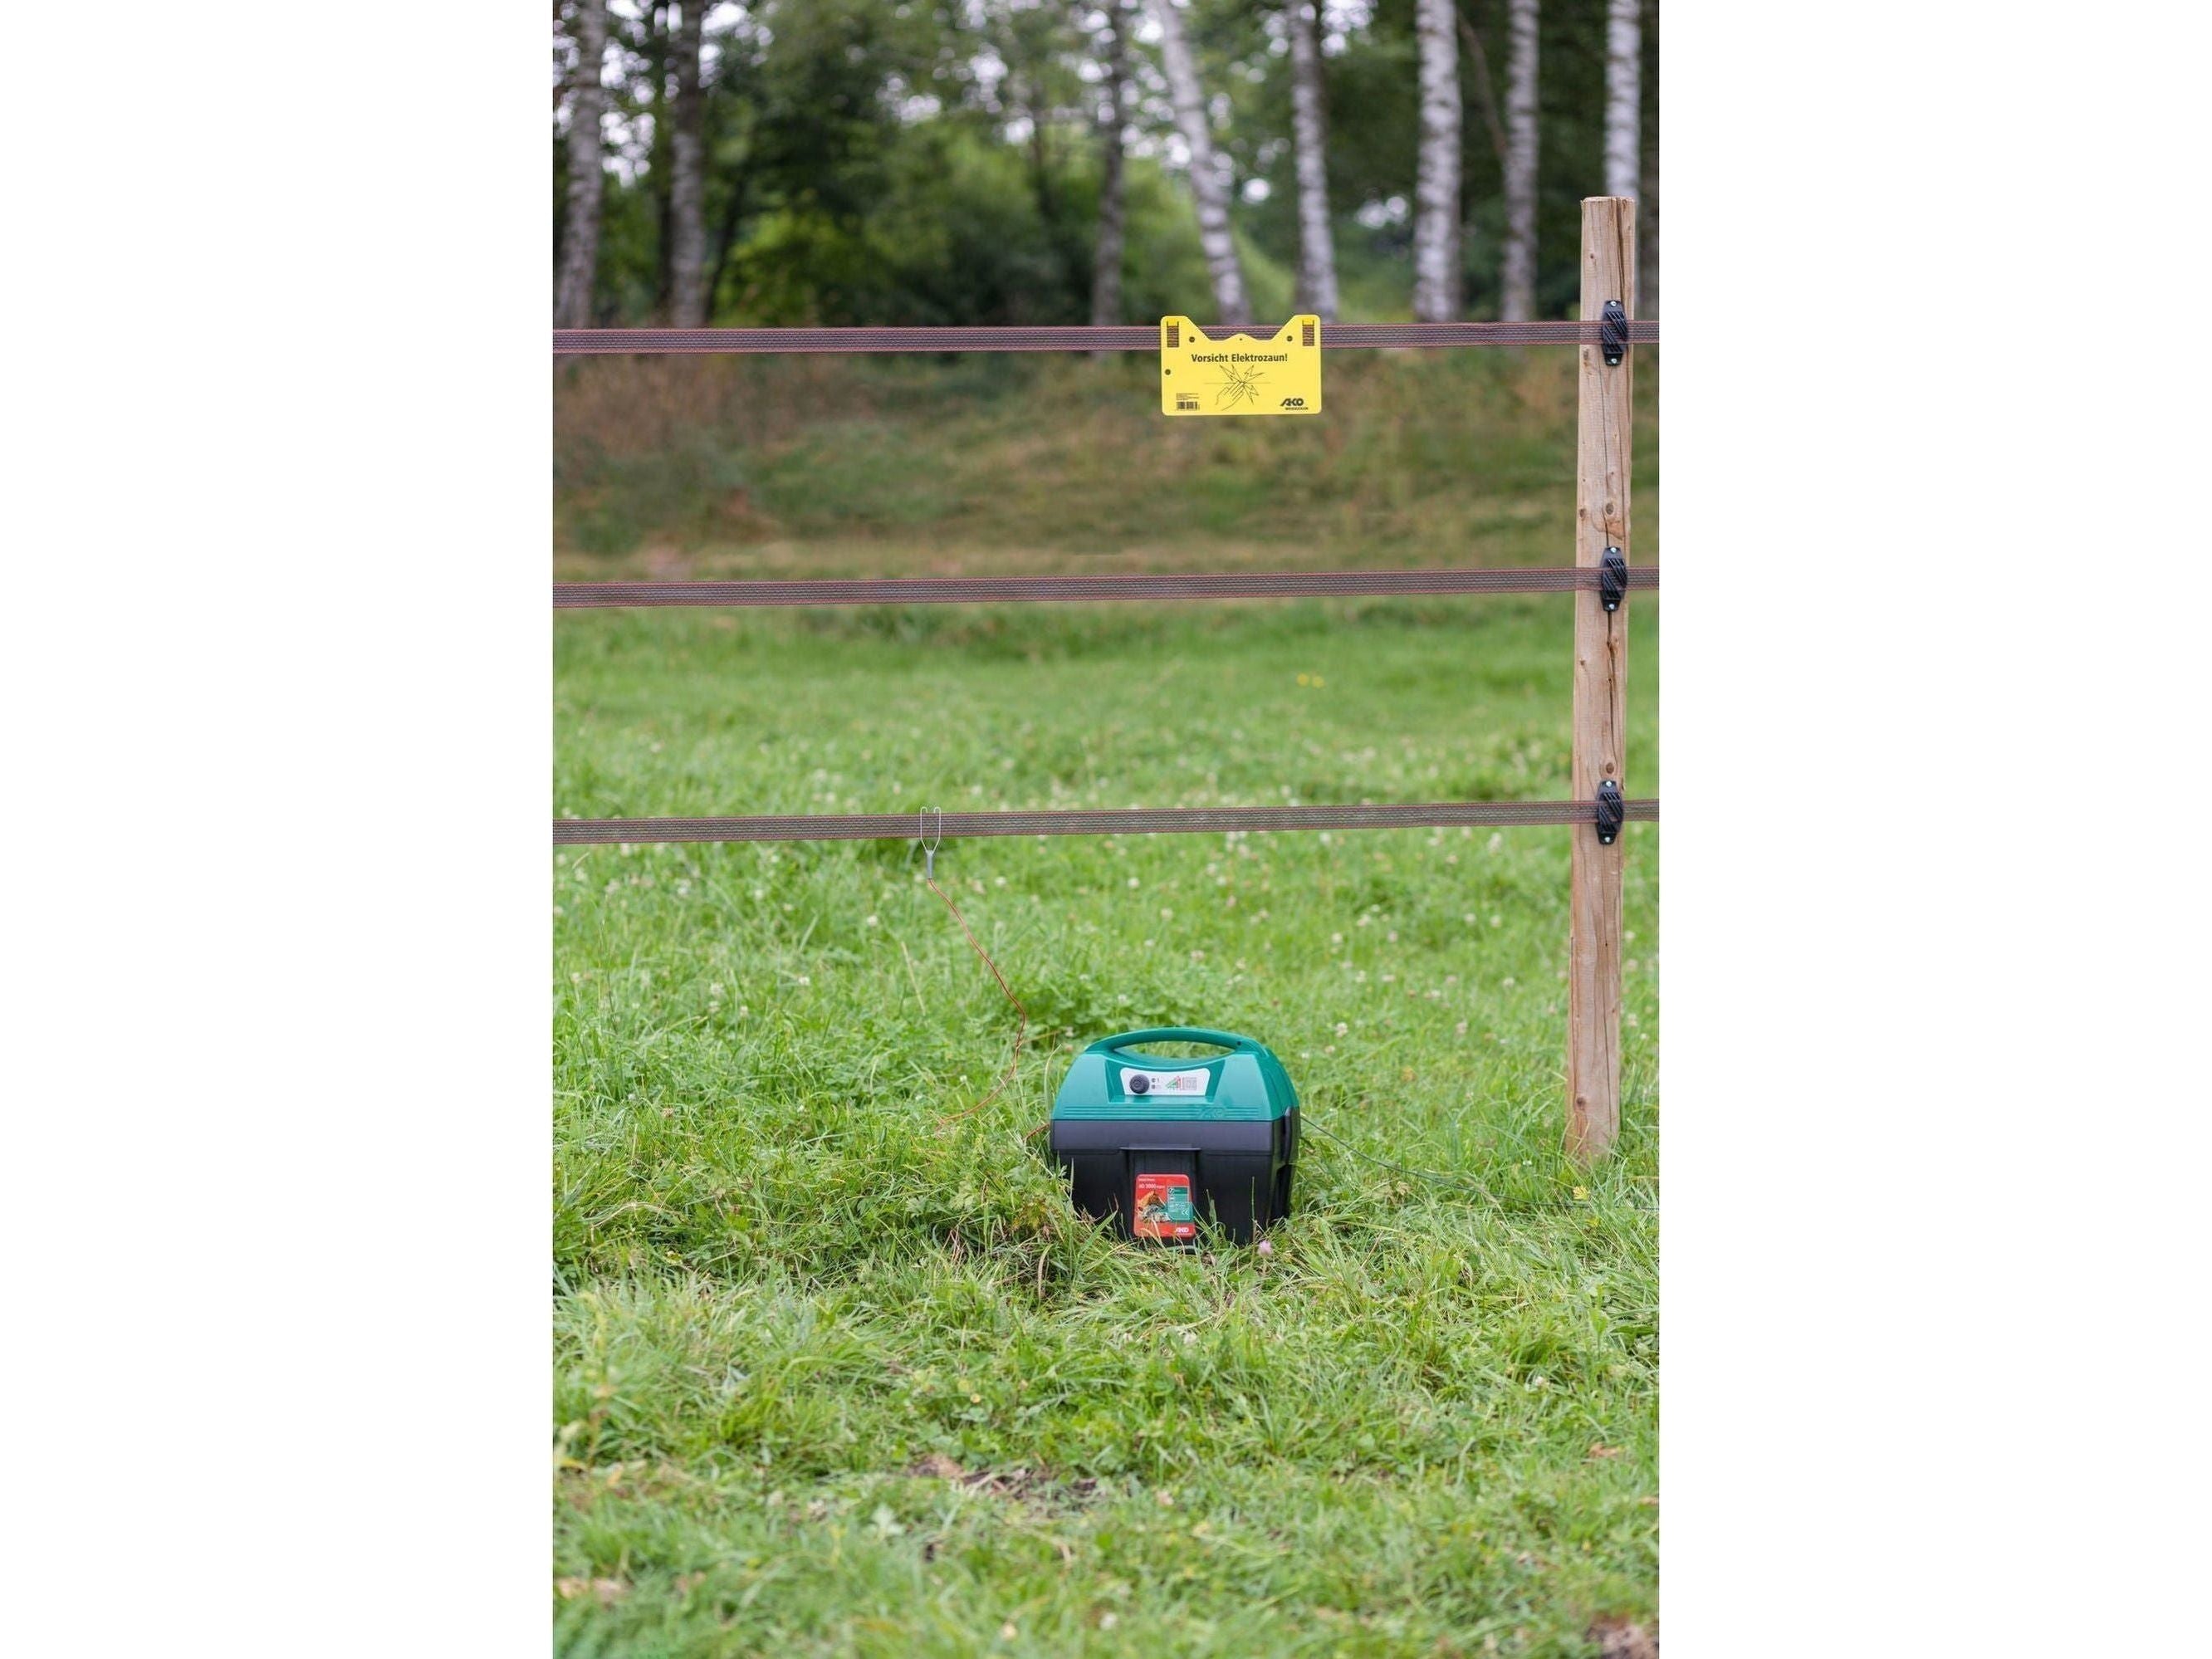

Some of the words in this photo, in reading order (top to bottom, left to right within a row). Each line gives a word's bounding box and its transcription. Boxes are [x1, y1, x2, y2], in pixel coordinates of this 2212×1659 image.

[1191, 354, 1228, 363] Vorsicht
[1231, 353, 1288, 363] Elektrozaun!
[1280, 398, 1304, 407] AKO
